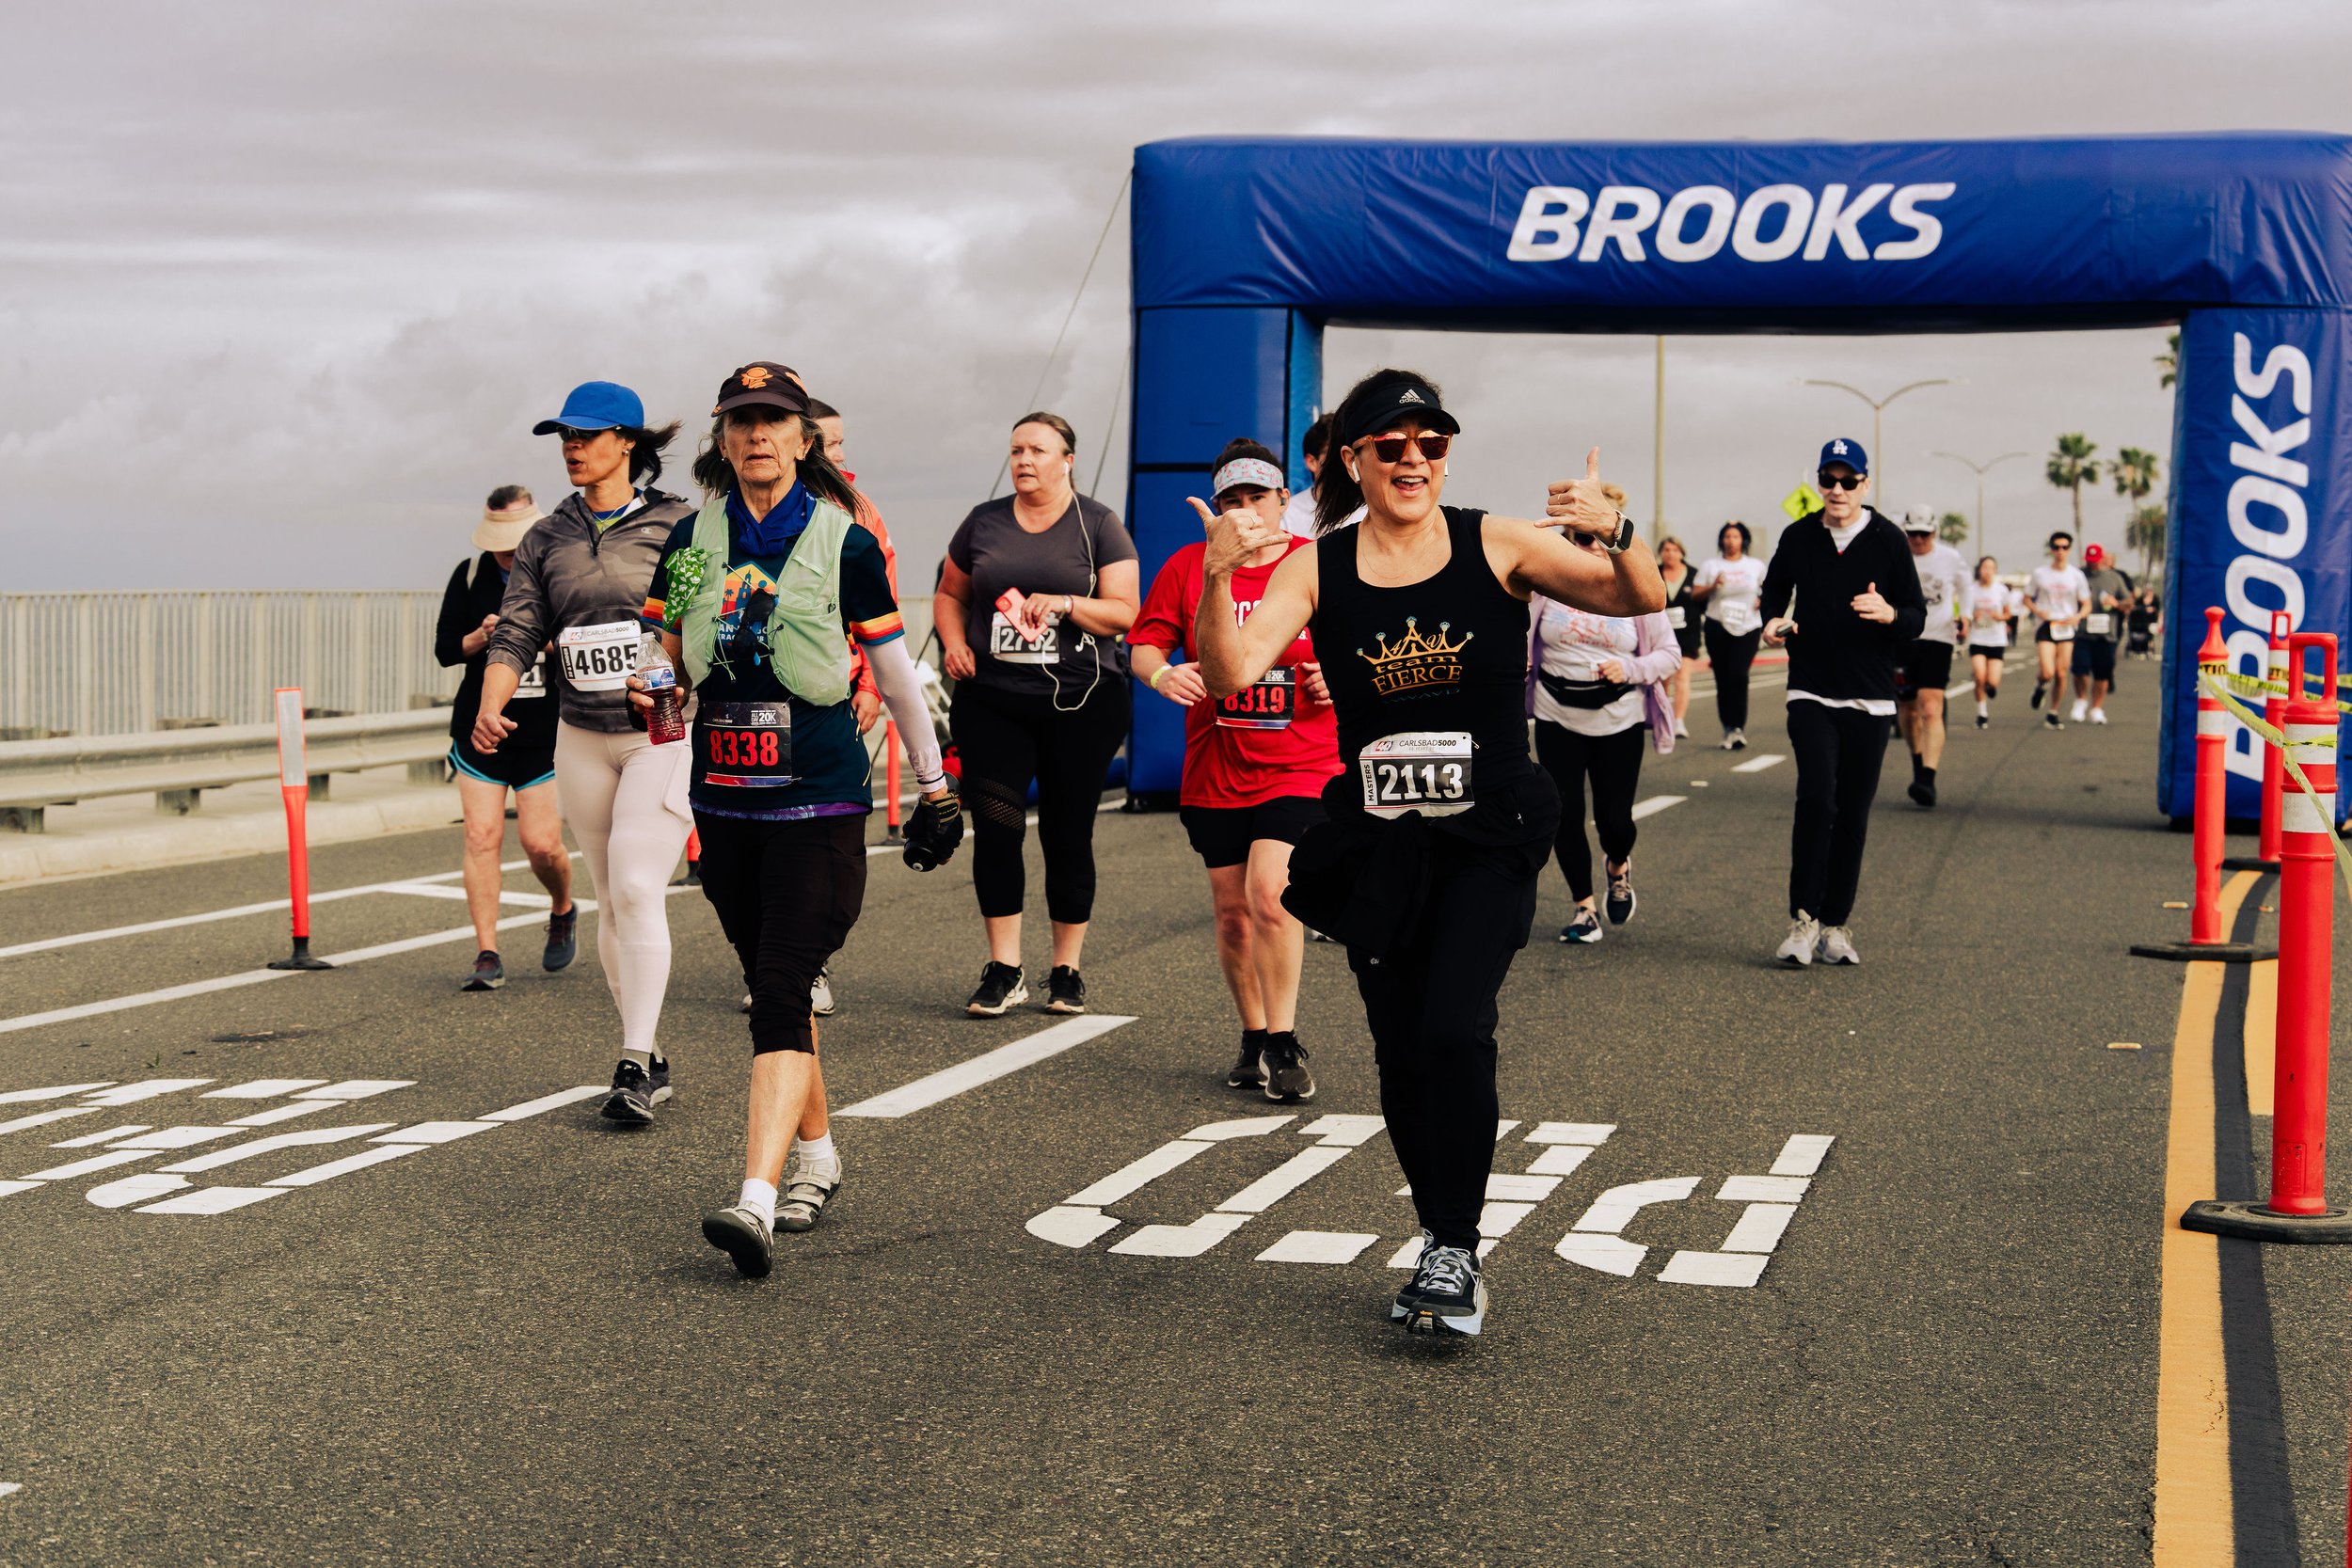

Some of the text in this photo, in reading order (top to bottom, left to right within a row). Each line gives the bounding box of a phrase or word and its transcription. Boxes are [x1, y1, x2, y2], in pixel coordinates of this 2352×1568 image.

[1506, 182, 1956, 262] BROOKS
[575, 643, 638, 675] 4685
[1375, 655, 1459, 674] team
[1372, 665, 1463, 693] FIERCE
[1224, 686, 1285, 714] 8319
[758, 712, 776, 722] 20K
[709, 730, 779, 767] 8338
[1363, 764, 1375, 801] MASTERS
[1377, 763, 1465, 801] 2113
